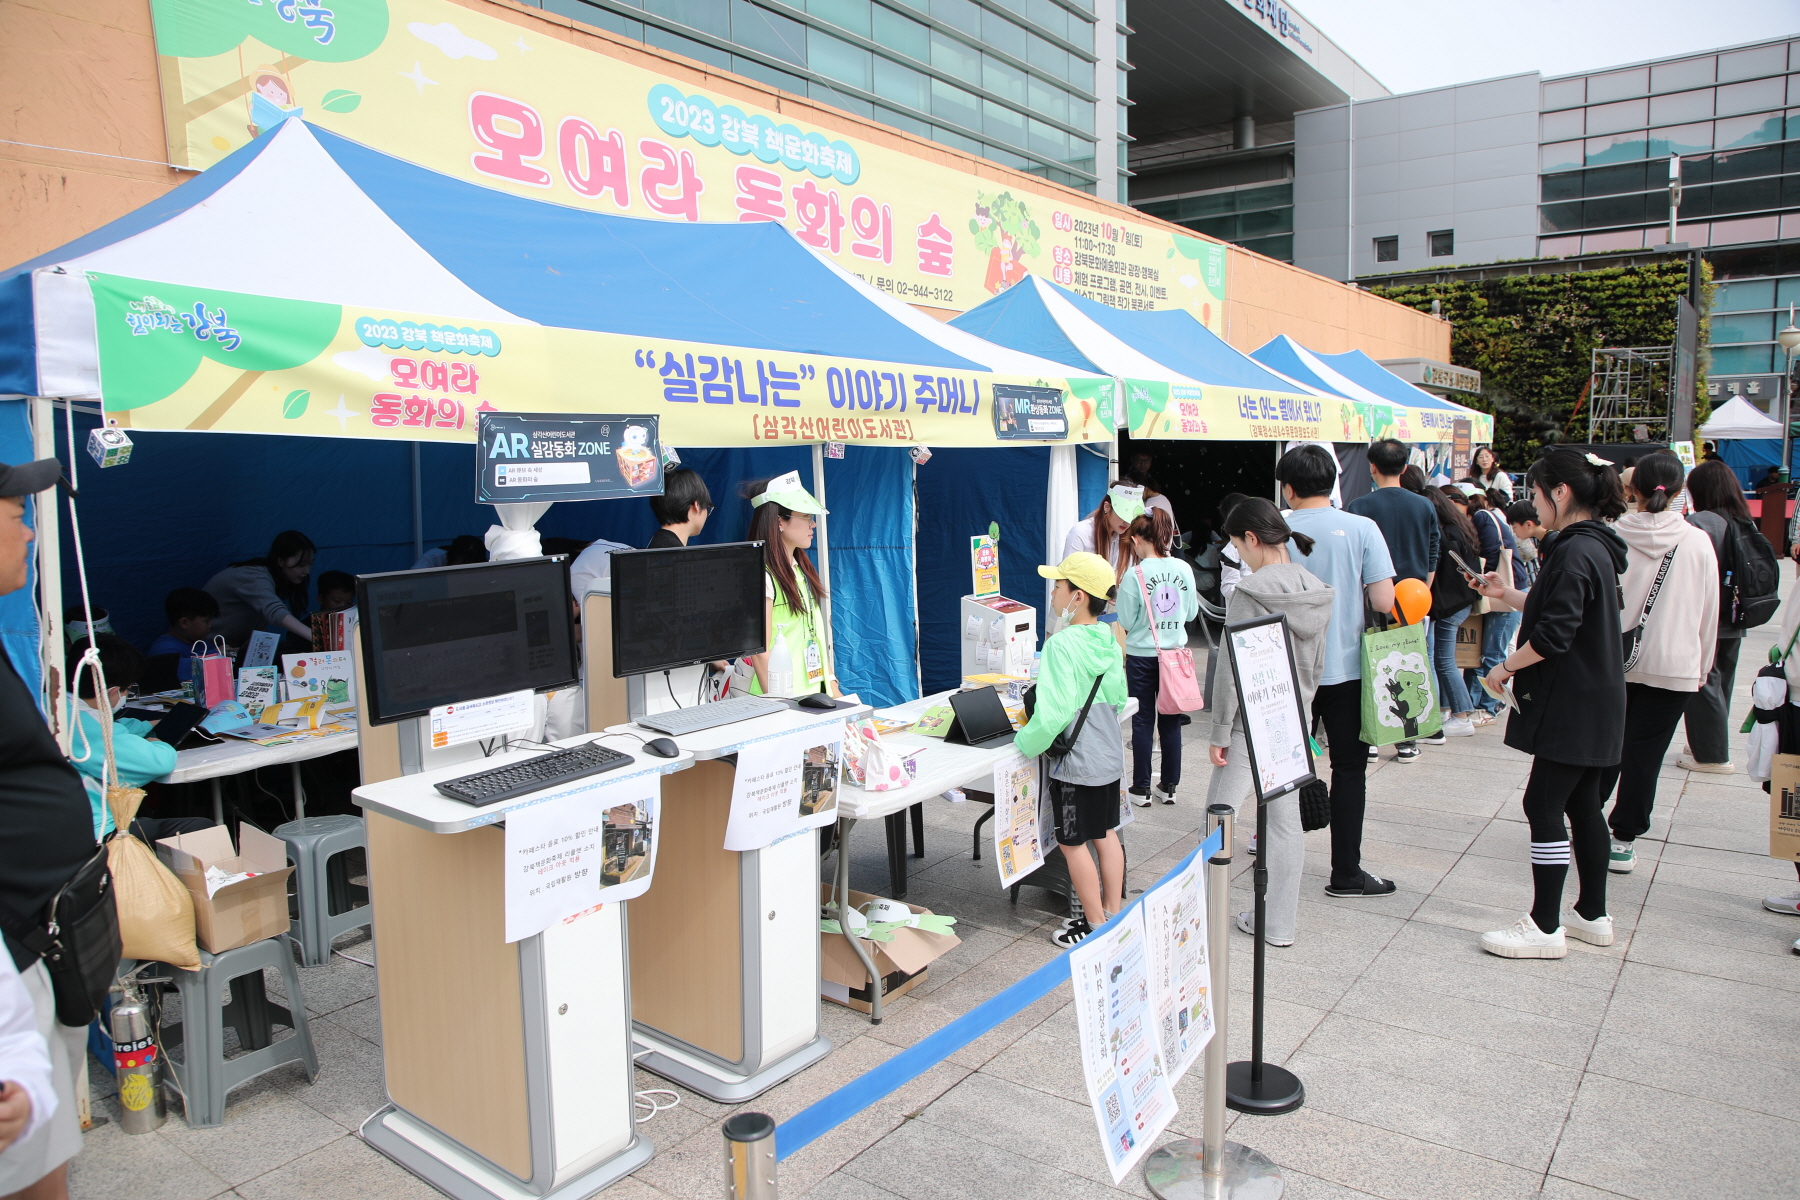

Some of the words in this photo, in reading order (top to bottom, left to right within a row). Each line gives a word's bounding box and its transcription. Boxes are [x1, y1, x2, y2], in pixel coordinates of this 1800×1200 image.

[660, 96, 715, 135] 2023
[721, 112, 759, 146] 강북
[764, 126, 853, 177] 책문화축제
[469, 92, 704, 222] 모여라
[735, 164, 894, 267] 동화의
[916, 213, 954, 278] 숲
[1054, 213, 1071, 231] 일시
[1074, 219, 1099, 238] 2023년
[1101, 222, 1118, 242] 10월
[1054, 247, 1071, 265] 장소
[1074, 236, 1116, 257] 11:00~17:30
[1054, 267, 1072, 284] 내용
[1074, 252, 1127, 275] 강북문화예술회관
[877, 277, 894, 294] 문의
[897, 281, 954, 302] 02-944-3122
[1074, 271, 1088, 286] 체험
[1117, 296, 1131, 311] 작가
[180, 301, 242, 351] 강북
[362, 323, 399, 340] 2023
[401, 326, 428, 343] 강북
[430, 329, 494, 349] 책문화축제
[390, 357, 480, 395] 모여라
[826, 366, 908, 413] 이야기
[913, 374, 980, 416] 주머니
[370, 393, 465, 431] 동화의
[1014, 397, 1031, 415] MR
[1048, 404, 1063, 415] ZONE
[1237, 394, 1259, 420] 너는
[1259, 396, 1279, 420] 어느
[1279, 398, 1304, 422] 별에서
[1303, 400, 1322, 423] 왔니?
[489, 432, 531, 459] AR
[530, 440, 577, 459] 실감동화
[578, 441, 612, 456] ZONE
[1172, 575, 1188, 592] POP
[1646, 583, 1660, 607] MAJOR
[1655, 558, 1671, 584] LEAGUE
[1375, 644, 1389, 652] love
[1402, 638, 1420, 649] planet
[1247, 687, 1269, 705] 이야기
[1271, 680, 1291, 699] 주머니
[561, 834, 573, 843] 10%
[575, 829, 587, 840] 할인
[587, 825, 599, 836] 안내
[522, 852, 563, 873] 강북책문화축제
[583, 843, 595, 852] 소지
[529, 886, 541, 897] 위치
[574, 867, 589, 879] 방향
